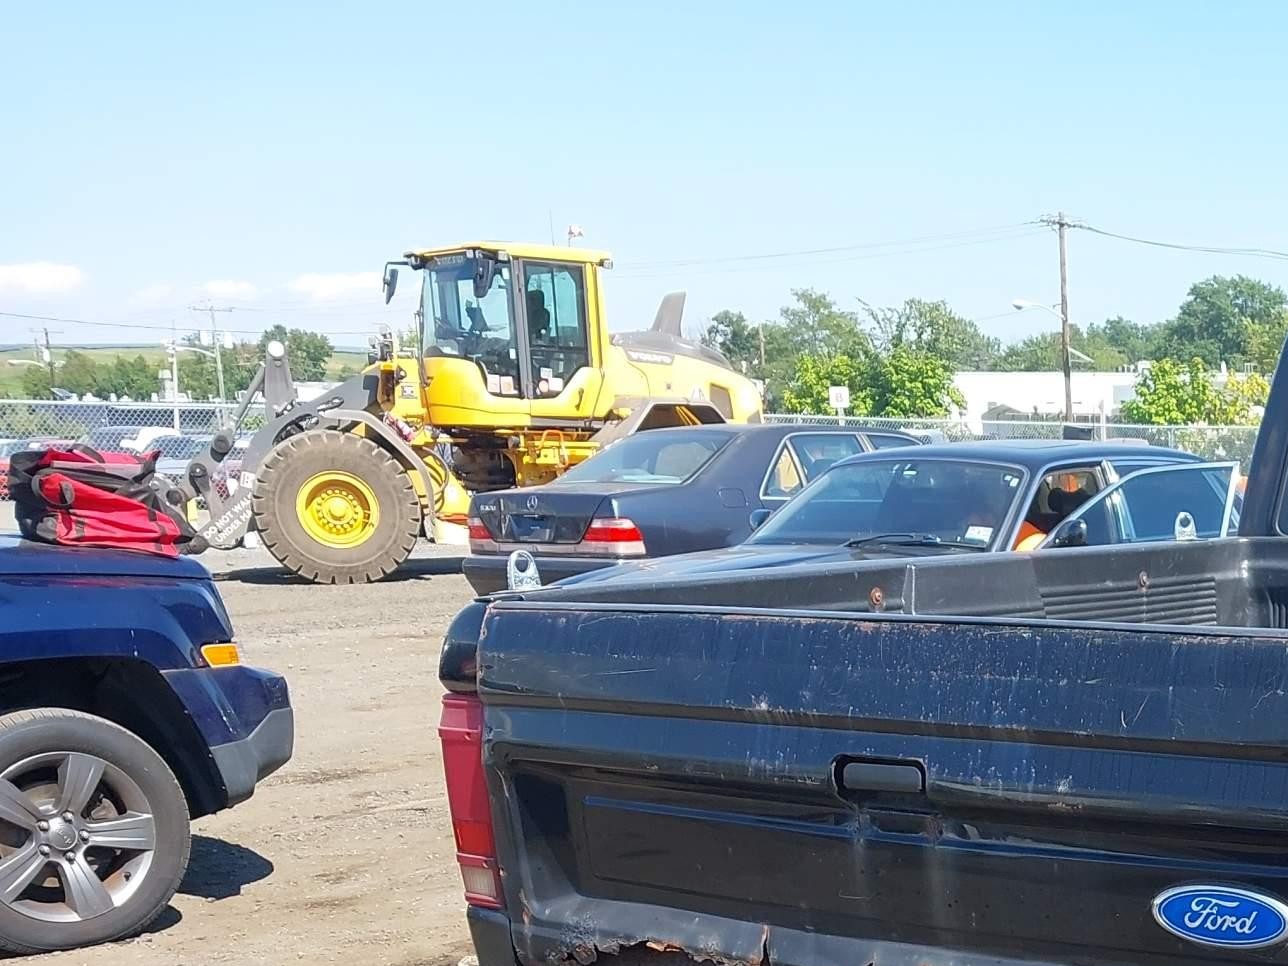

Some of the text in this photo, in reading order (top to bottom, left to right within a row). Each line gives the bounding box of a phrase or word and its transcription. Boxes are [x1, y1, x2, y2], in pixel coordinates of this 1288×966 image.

[203, 526, 217, 539] DO
[215, 510, 234, 529] NOT
[215, 519, 242, 543] UNDER
[1184, 897, 1258, 934] Ford
